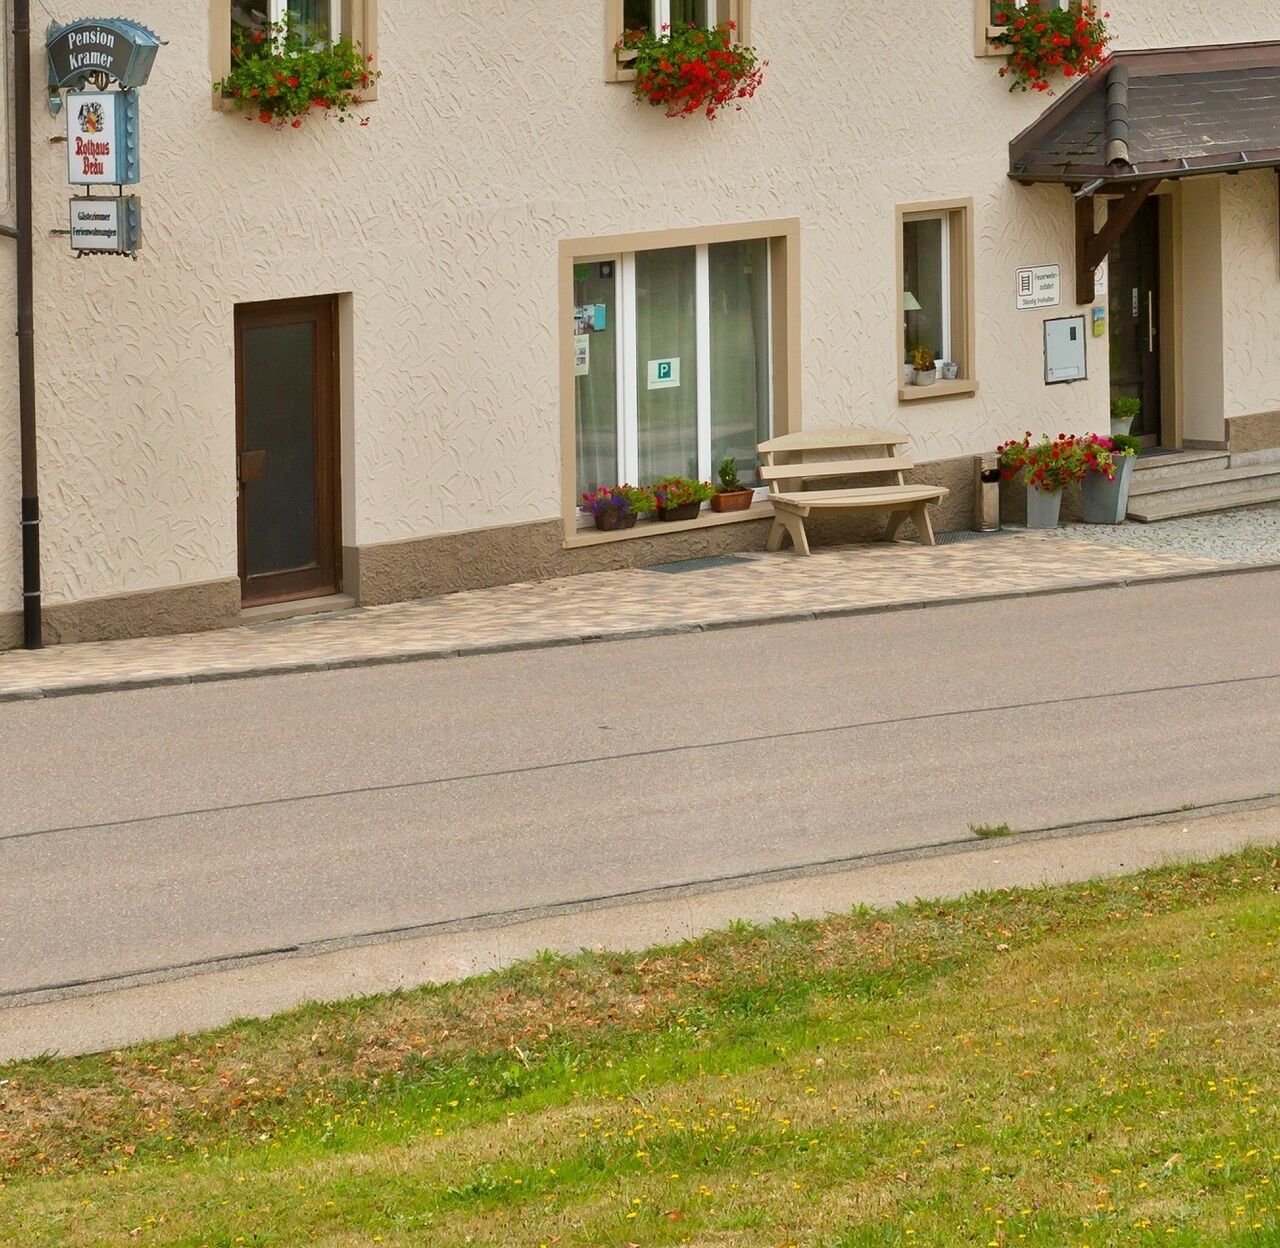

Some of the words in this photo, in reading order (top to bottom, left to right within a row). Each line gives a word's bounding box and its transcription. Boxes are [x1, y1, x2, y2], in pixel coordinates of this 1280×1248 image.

[67, 27, 115, 50] Pension
[68, 47, 114, 70] Kramer
[75, 135, 110, 160] Rothaus
[77, 211, 111, 221] Gästezimmer
[72, 227, 117, 238] Ferienwohnungen
